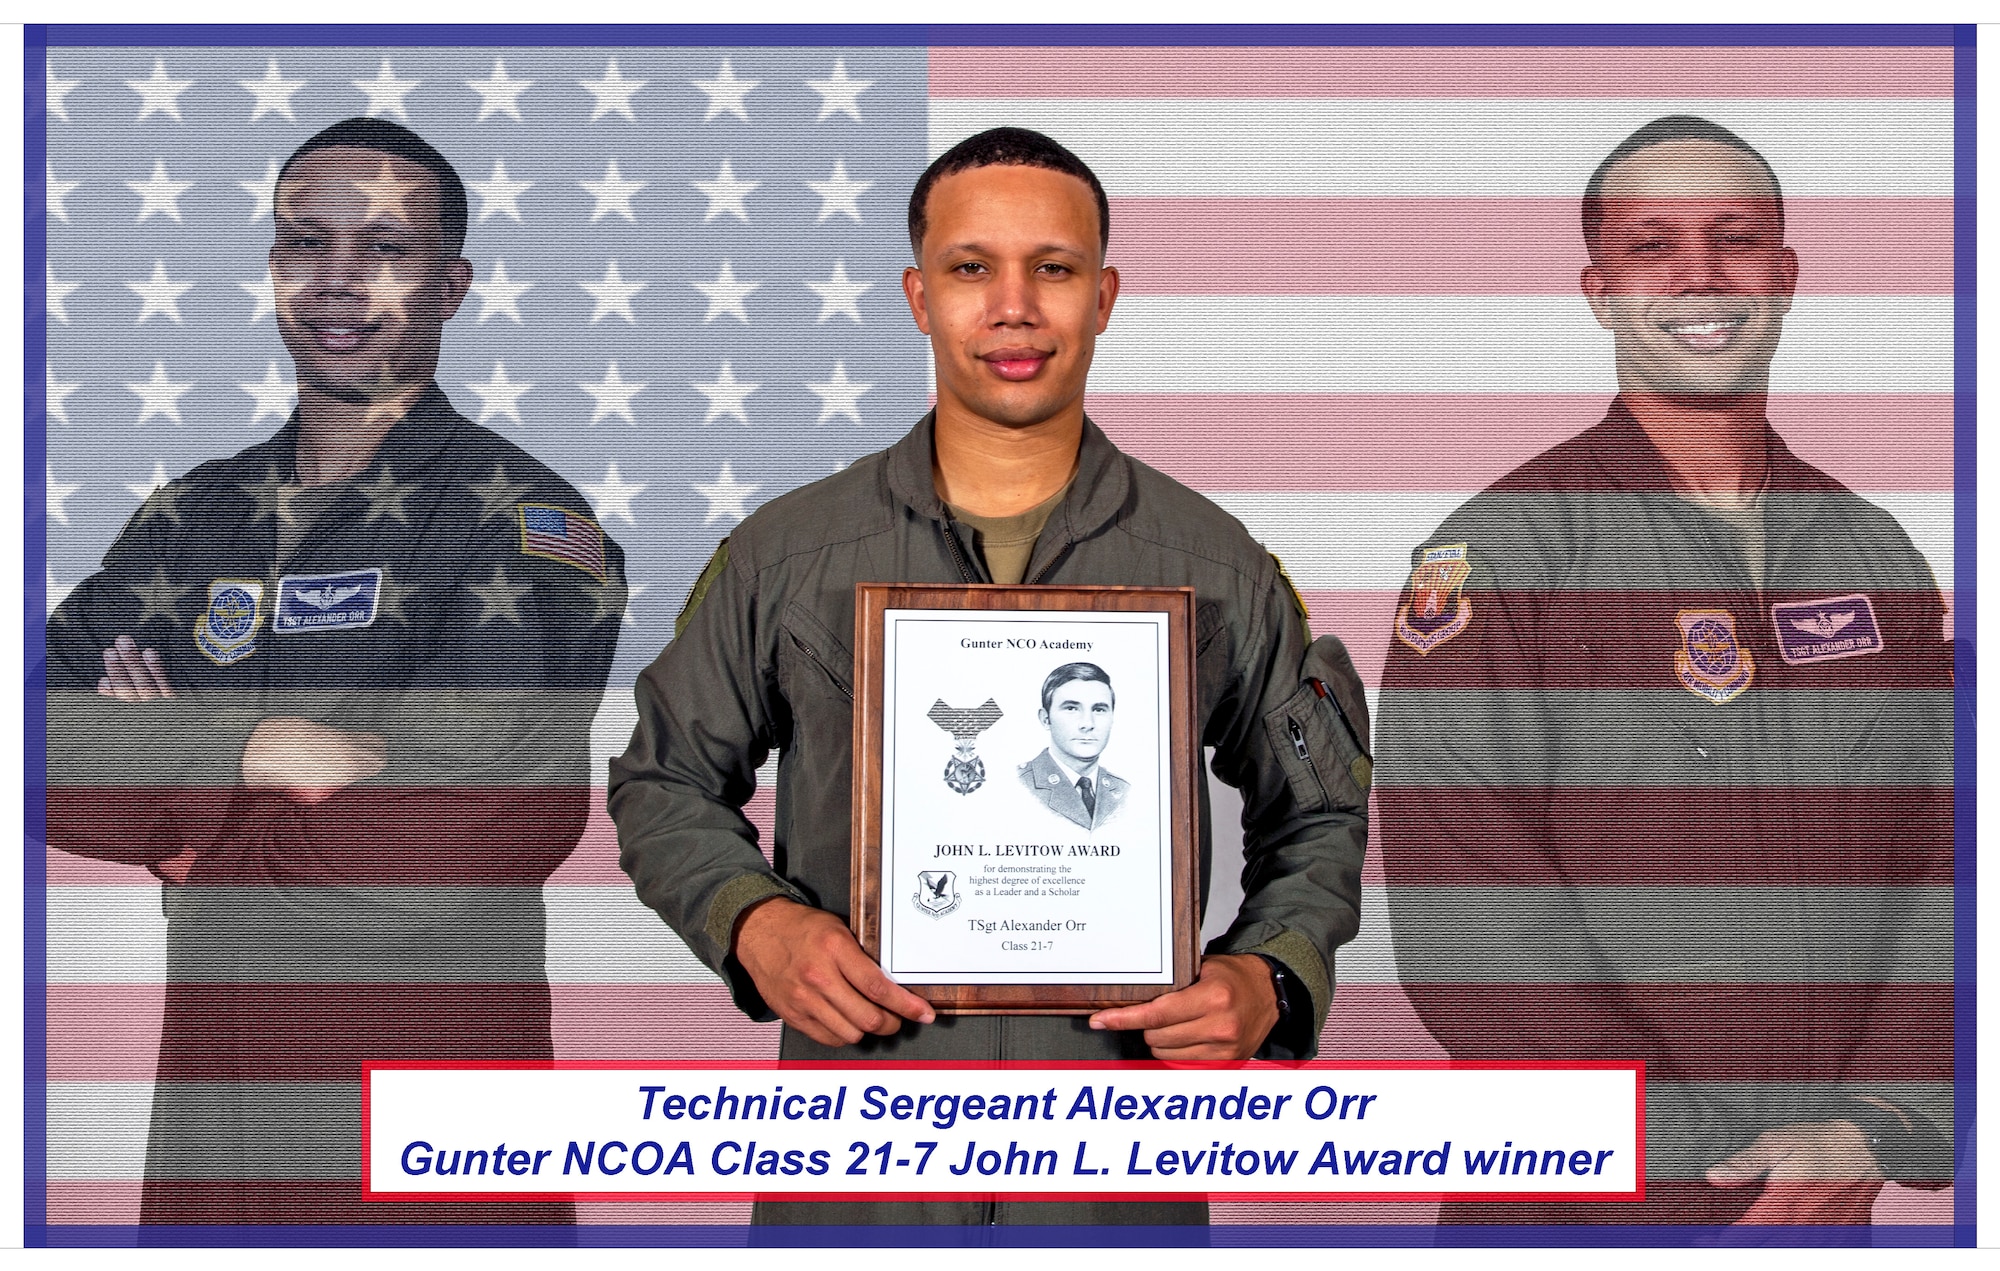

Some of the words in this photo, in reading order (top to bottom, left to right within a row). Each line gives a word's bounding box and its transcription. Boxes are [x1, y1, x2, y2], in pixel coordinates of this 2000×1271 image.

[303, 611, 347, 626] ALEXANDER
[349, 610, 365, 621] ORR
[960, 637, 1003, 649] Gunter
[1006, 638, 1037, 649] NCO
[1040, 639, 1093, 652] Academy
[1790, 644, 1809, 658] TSGT
[1812, 638, 1855, 655] ALEXANDER
[1856, 636, 1872, 648] ORR
[933, 844, 974, 859] JOHN
[978, 844, 991, 857] L.
[996, 844, 1064, 857] LEVITOW
[1067, 845, 1121, 857] AWARD
[983, 864, 996, 873] for
[997, 864, 1057, 876] demonstrating
[1058, 864, 1072, 873] the
[969, 875, 999, 887] highest
[1001, 876, 1029, 887] degree
[1031, 876, 1040, 885] of
[1042, 876, 1086, 885] excellence
[993, 887, 1022, 896] Leader
[1024, 887, 1040, 896] and
[1048, 887, 1081, 897] Scholar
[967, 919, 997, 934] TSgt
[1000, 919, 1063, 931] Alexander
[1065, 919, 1087, 931] Orr
[1001, 940, 1029, 951] Class
[1031, 940, 1054, 951] 21-7
